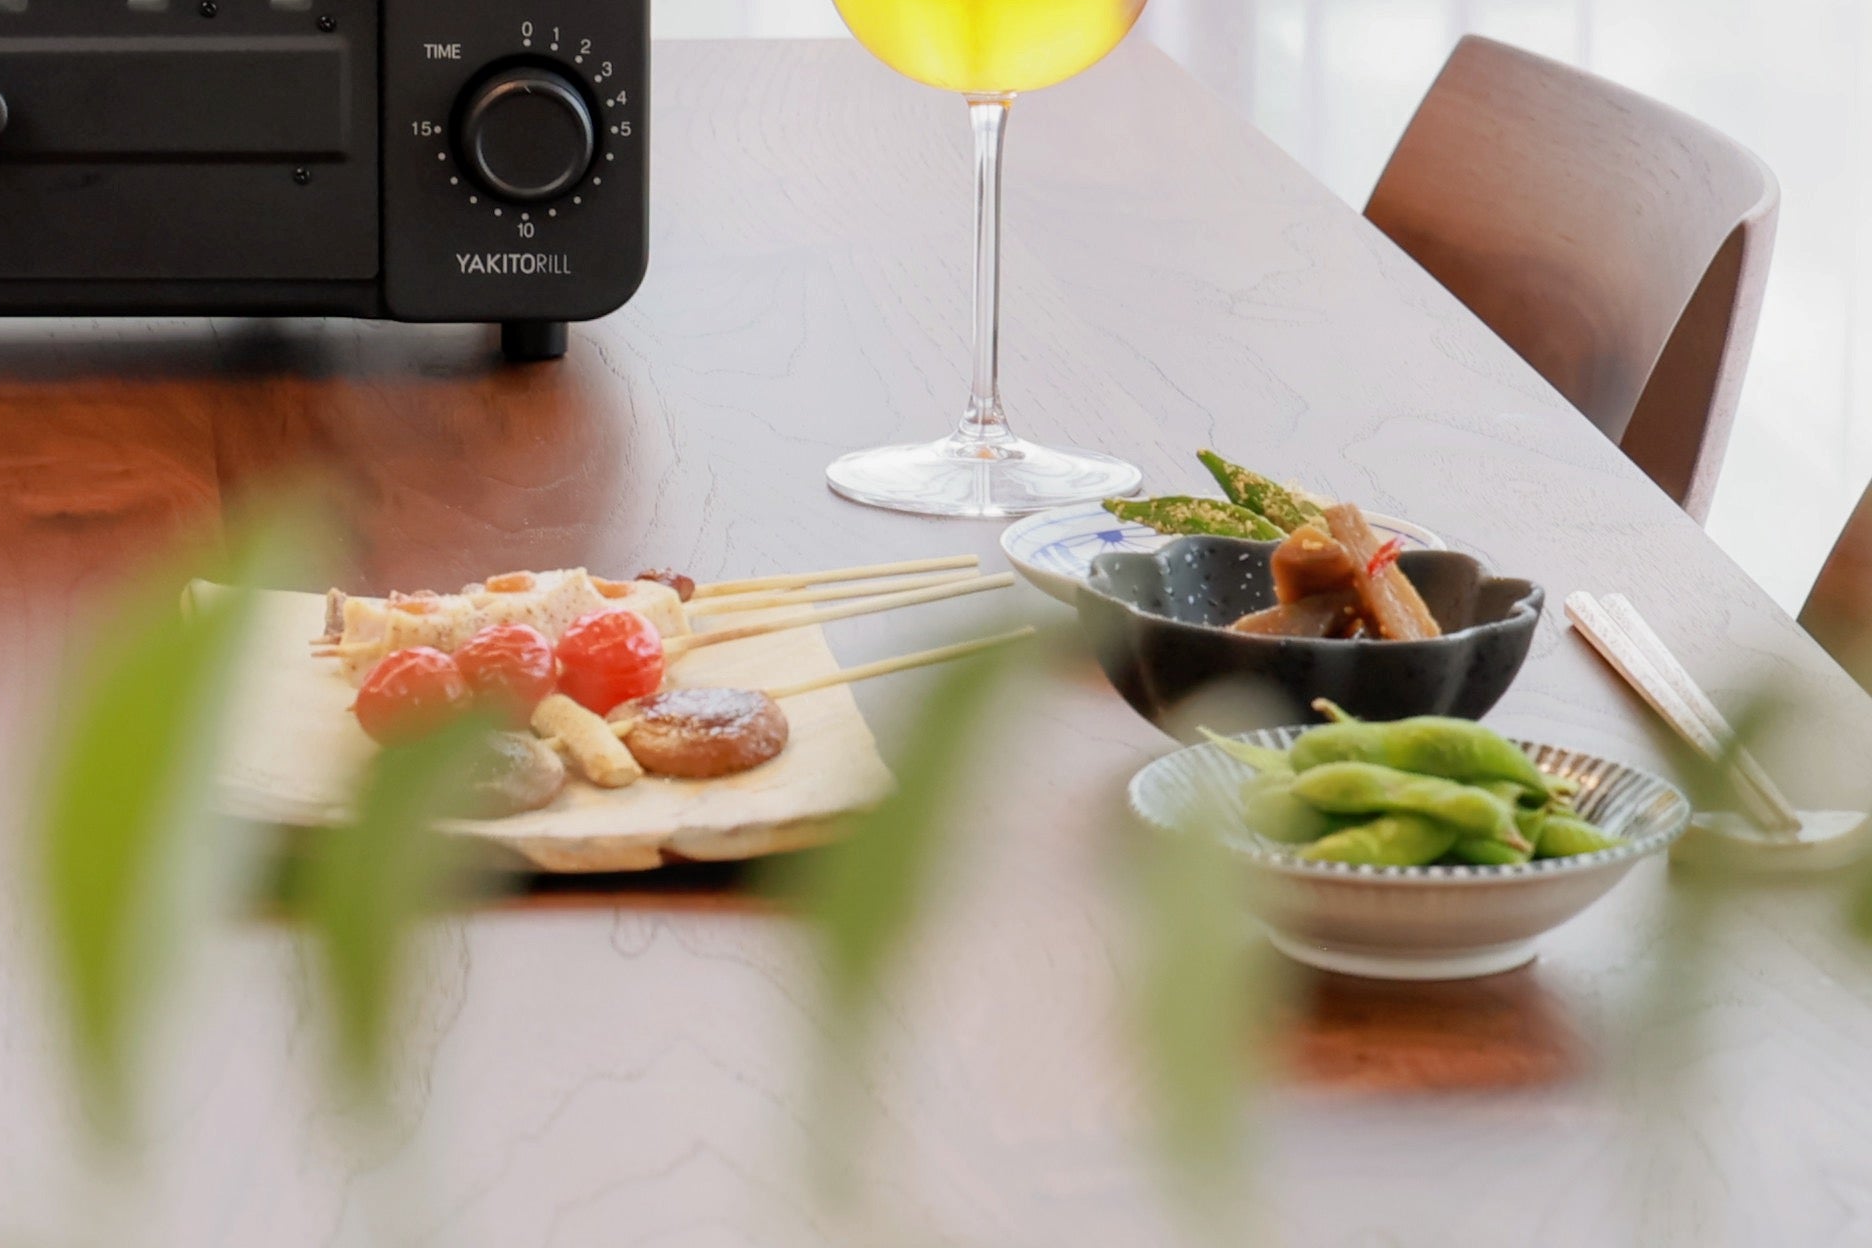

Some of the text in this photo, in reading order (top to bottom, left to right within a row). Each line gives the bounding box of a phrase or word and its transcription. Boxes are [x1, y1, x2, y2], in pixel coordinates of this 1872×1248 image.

[521, 20, 534, 38] 0
[551, 26, 561, 43] 1
[423, 42, 462, 60] TIME
[579, 38, 592, 55] 2
[600, 60, 614, 78] 3
[615, 89, 628, 106] 4
[410, 120, 433, 137] 15
[619, 120, 632, 137] 5
[516, 221, 536, 239] 10
[455, 252, 572, 275] YAKITORILL
